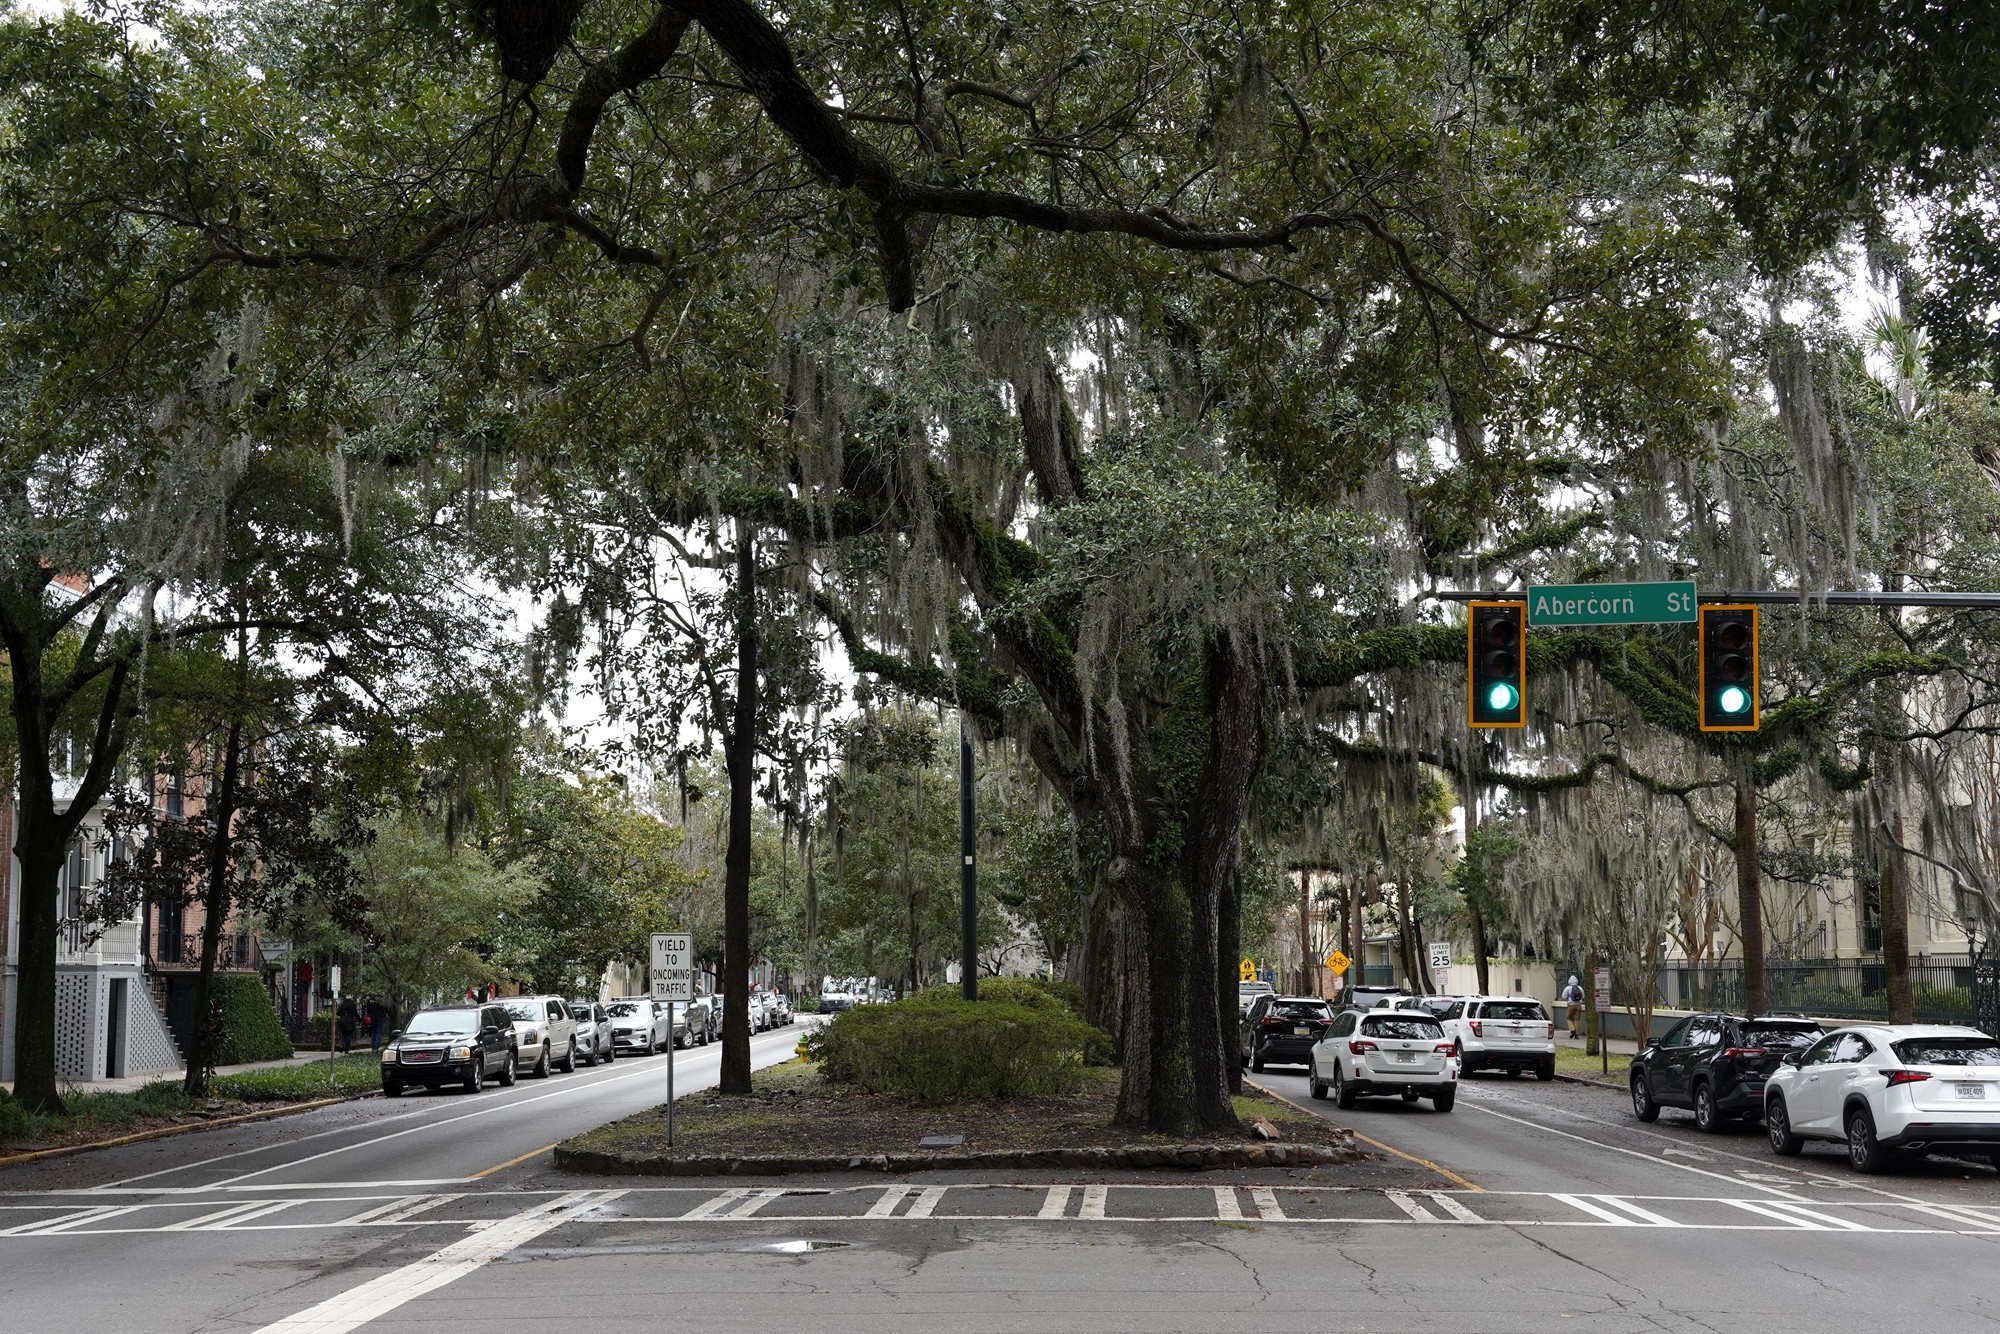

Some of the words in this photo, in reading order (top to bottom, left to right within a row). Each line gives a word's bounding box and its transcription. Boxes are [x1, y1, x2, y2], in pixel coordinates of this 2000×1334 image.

[1535, 595, 1634, 616] Abercorn
[1666, 592, 1690, 613] St
[657, 939, 686, 951] YIELD
[665, 954, 678, 965] TO
[1432, 956, 1450, 966] 25
[653, 968, 690, 980] ONCOMING
[656, 983, 687, 994] TRAFFIC
